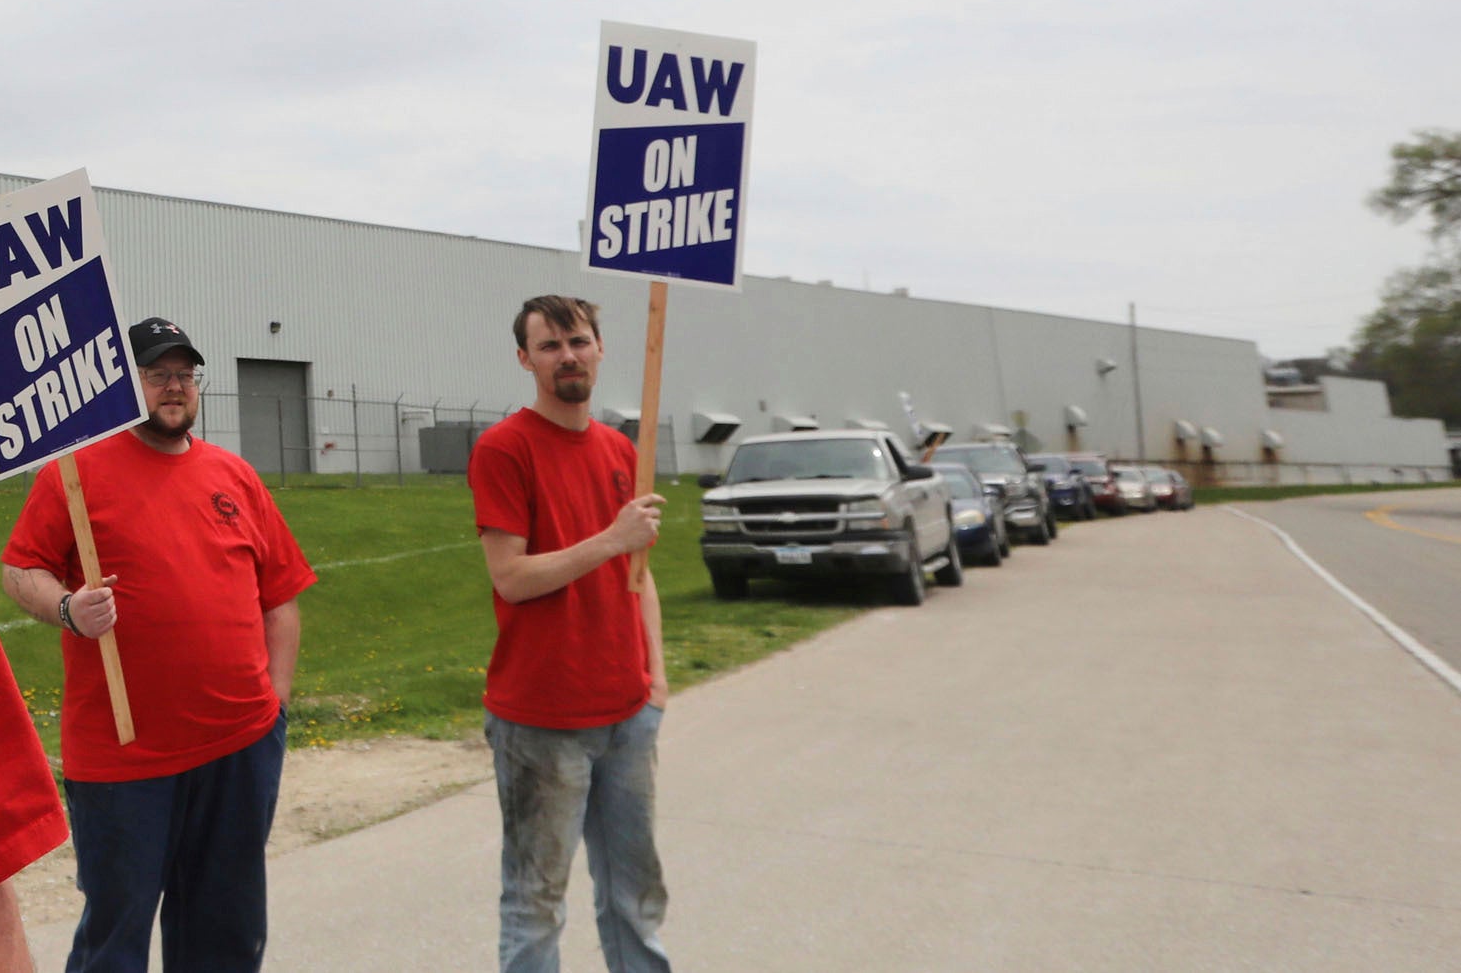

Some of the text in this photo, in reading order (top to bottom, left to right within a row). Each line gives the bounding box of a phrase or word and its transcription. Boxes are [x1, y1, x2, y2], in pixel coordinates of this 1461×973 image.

[607, 45, 745, 116] UAW
[643, 135, 698, 193] ON
[597, 188, 734, 259] STRIKE
[14, 294, 71, 373] ON
